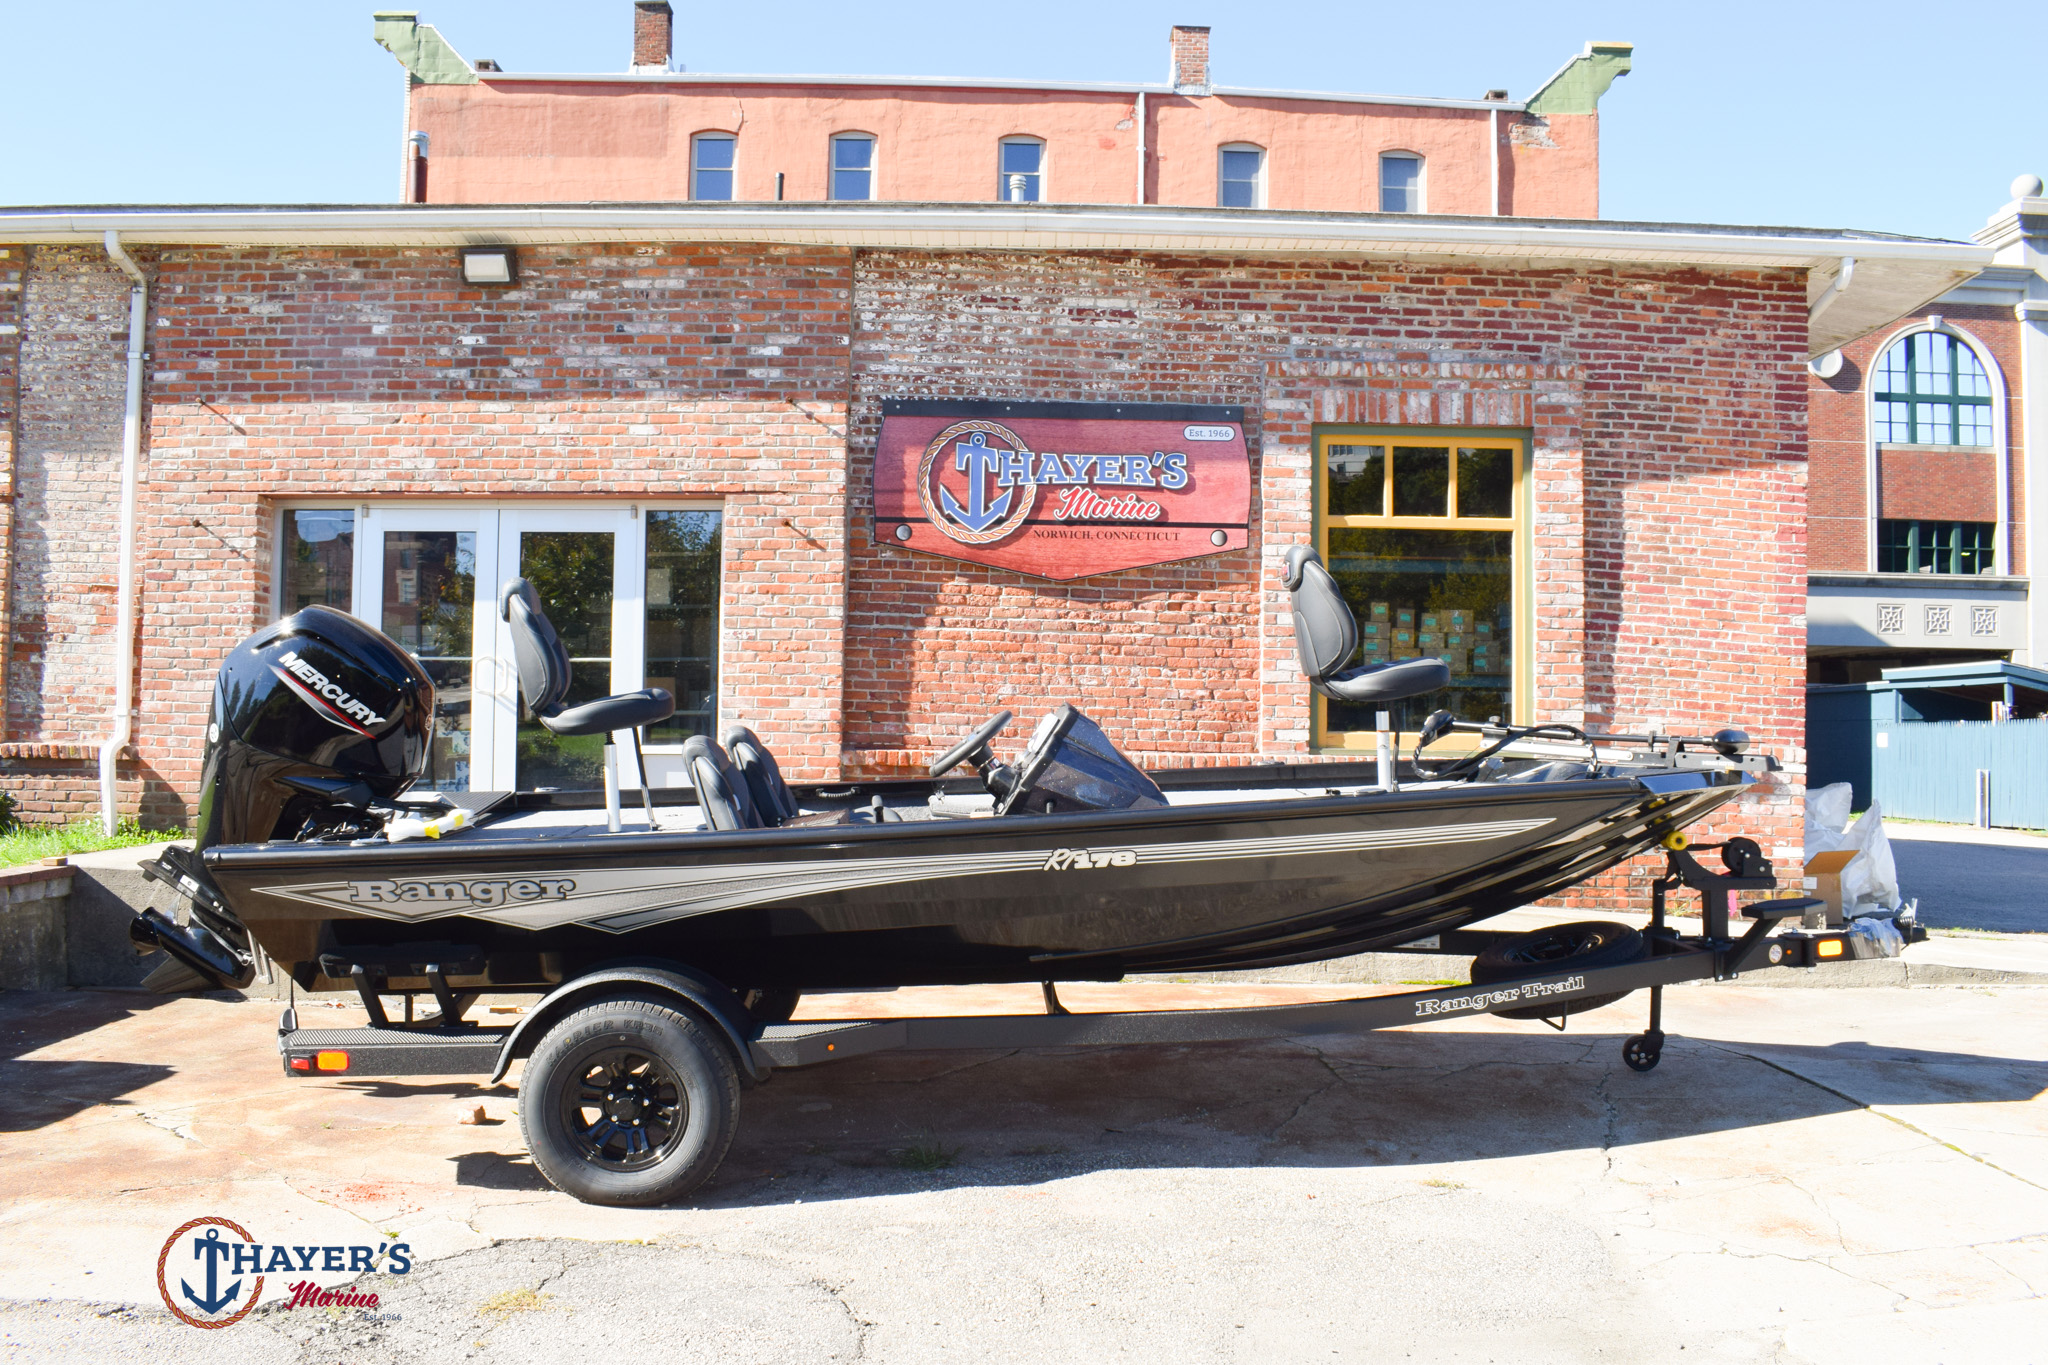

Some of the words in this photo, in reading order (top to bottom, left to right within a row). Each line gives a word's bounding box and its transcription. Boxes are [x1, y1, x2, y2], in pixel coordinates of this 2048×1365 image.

[1189, 428, 1206, 438] Est.
[1208, 429, 1230, 438] 1966
[952, 432, 1189, 491] THAYER'S
[1053, 485, 1161, 521] Marine
[1033, 529, 1094, 541] NORWICH,
[1096, 530, 1181, 542] CONNECTICUT
[278, 651, 387, 726] MERCURY
[348, 878, 577, 908] Ranger
[1415, 988, 1520, 1016] Ranger
[1521, 975, 1586, 998] Trail
